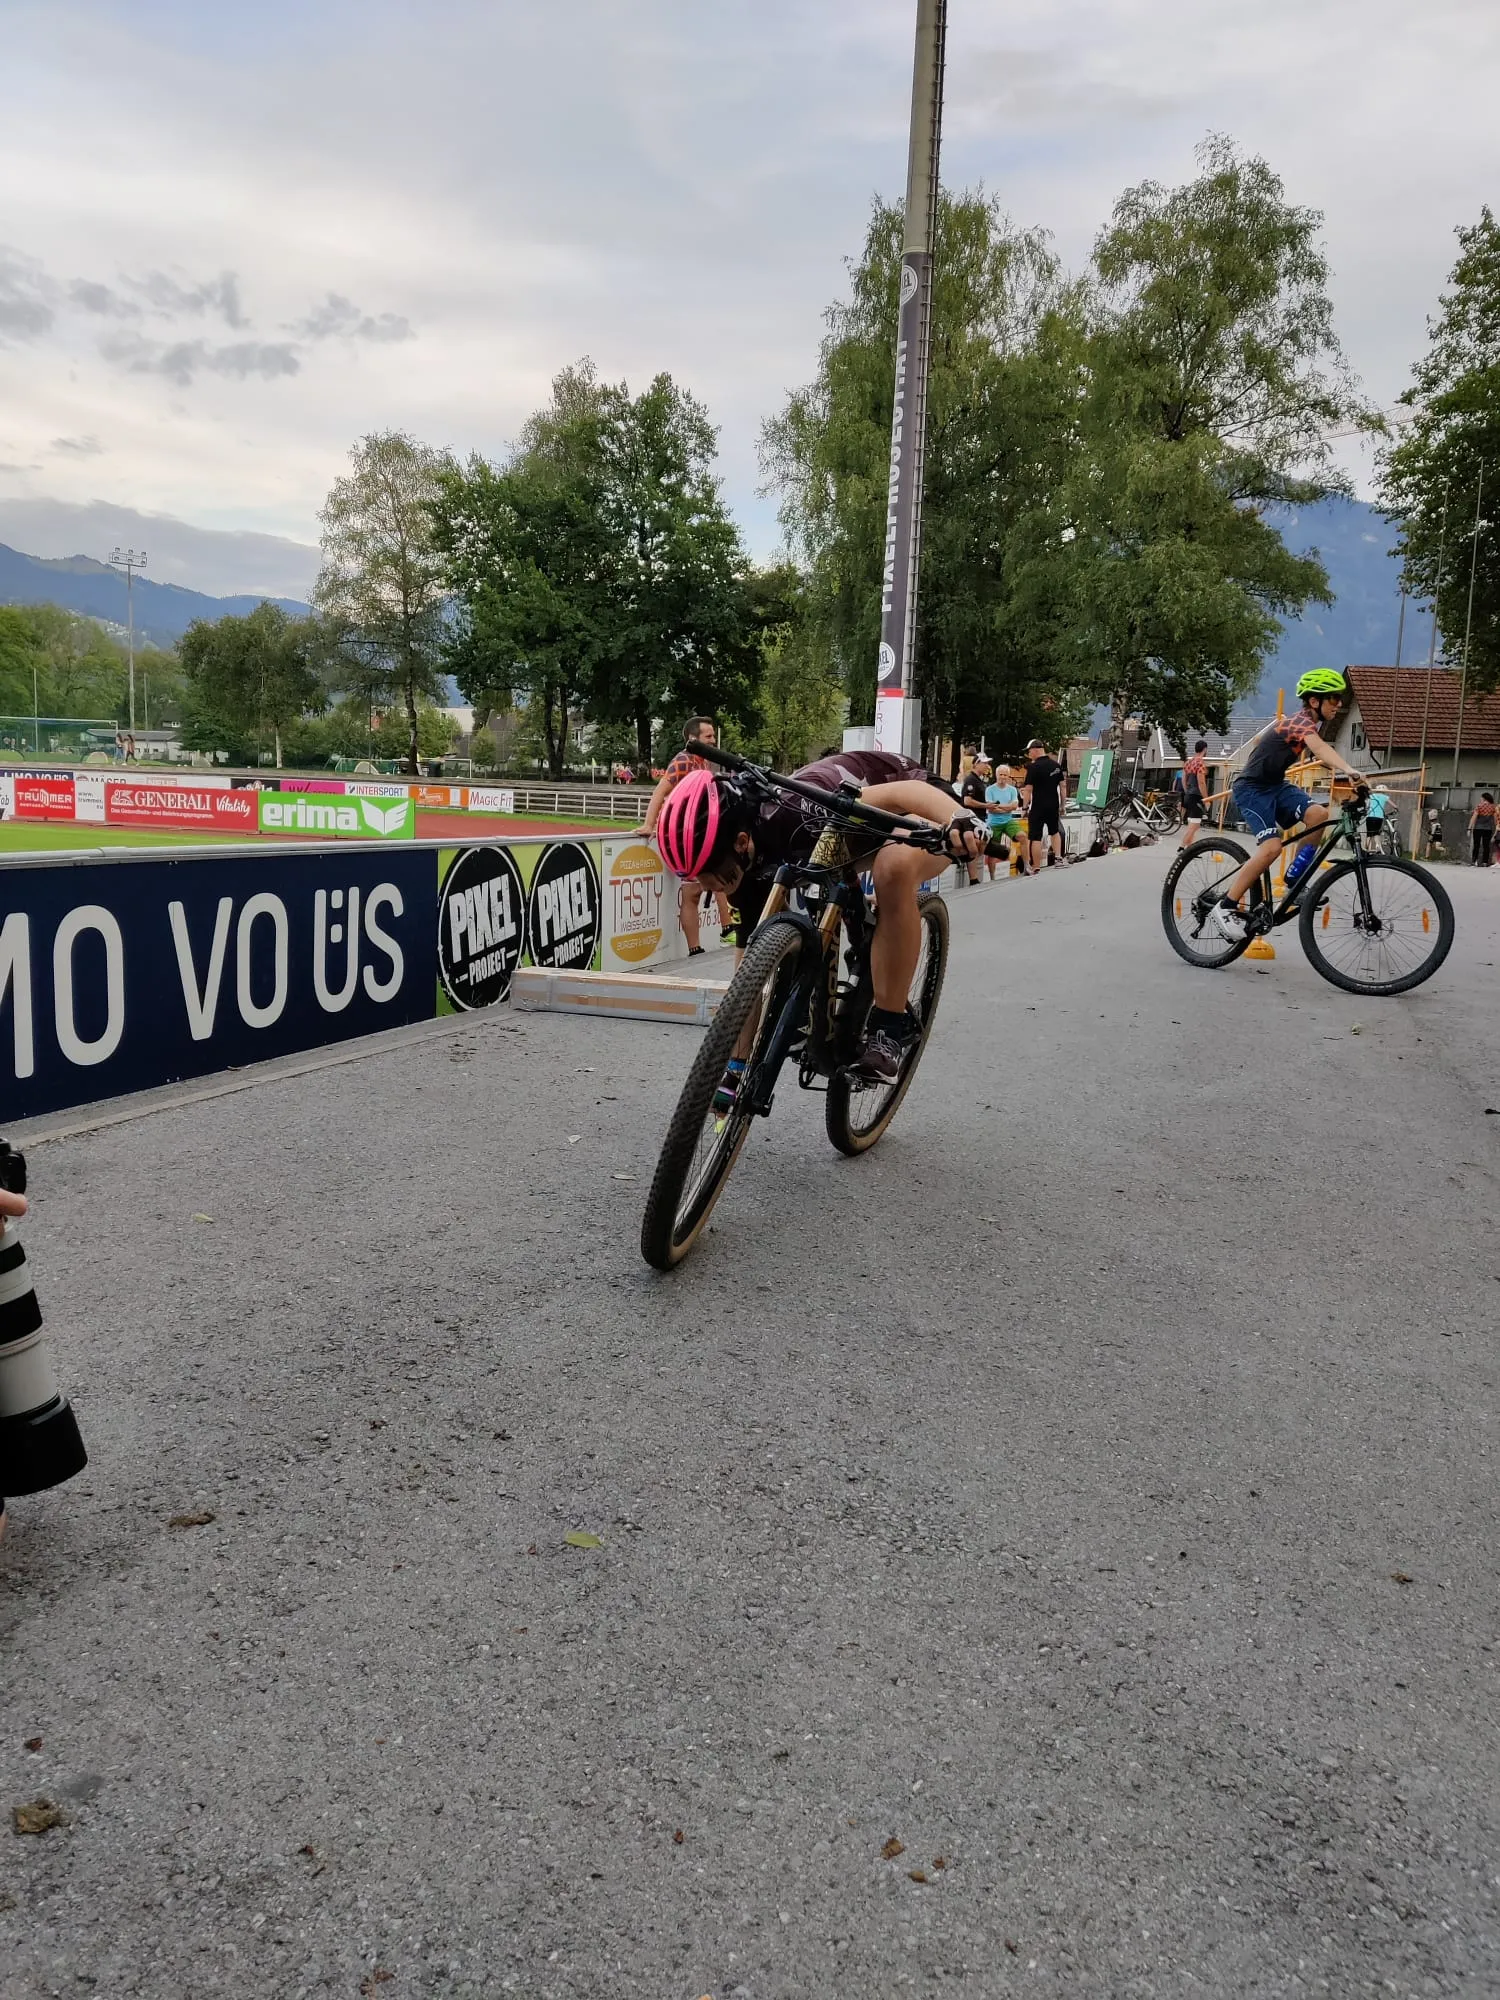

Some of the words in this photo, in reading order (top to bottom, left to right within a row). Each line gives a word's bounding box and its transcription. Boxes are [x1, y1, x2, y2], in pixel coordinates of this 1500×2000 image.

[134, 790, 212, 811] GENERALI
[216, 795, 251, 818] Vitality
[356, 786, 404, 797] INTERSPORT
[500, 793, 512, 807] FIT
[262, 798, 359, 831] erima
[449, 873, 516, 963] PIXEL
[537, 866, 593, 948] PIXEL
[609, 875, 664, 933] TASTY
[168, 892, 289, 1041] VO
[313, 882, 405, 1013] ÜS
[469, 947, 507, 986] PROJECT
[554, 933, 585, 968] PROJECT
